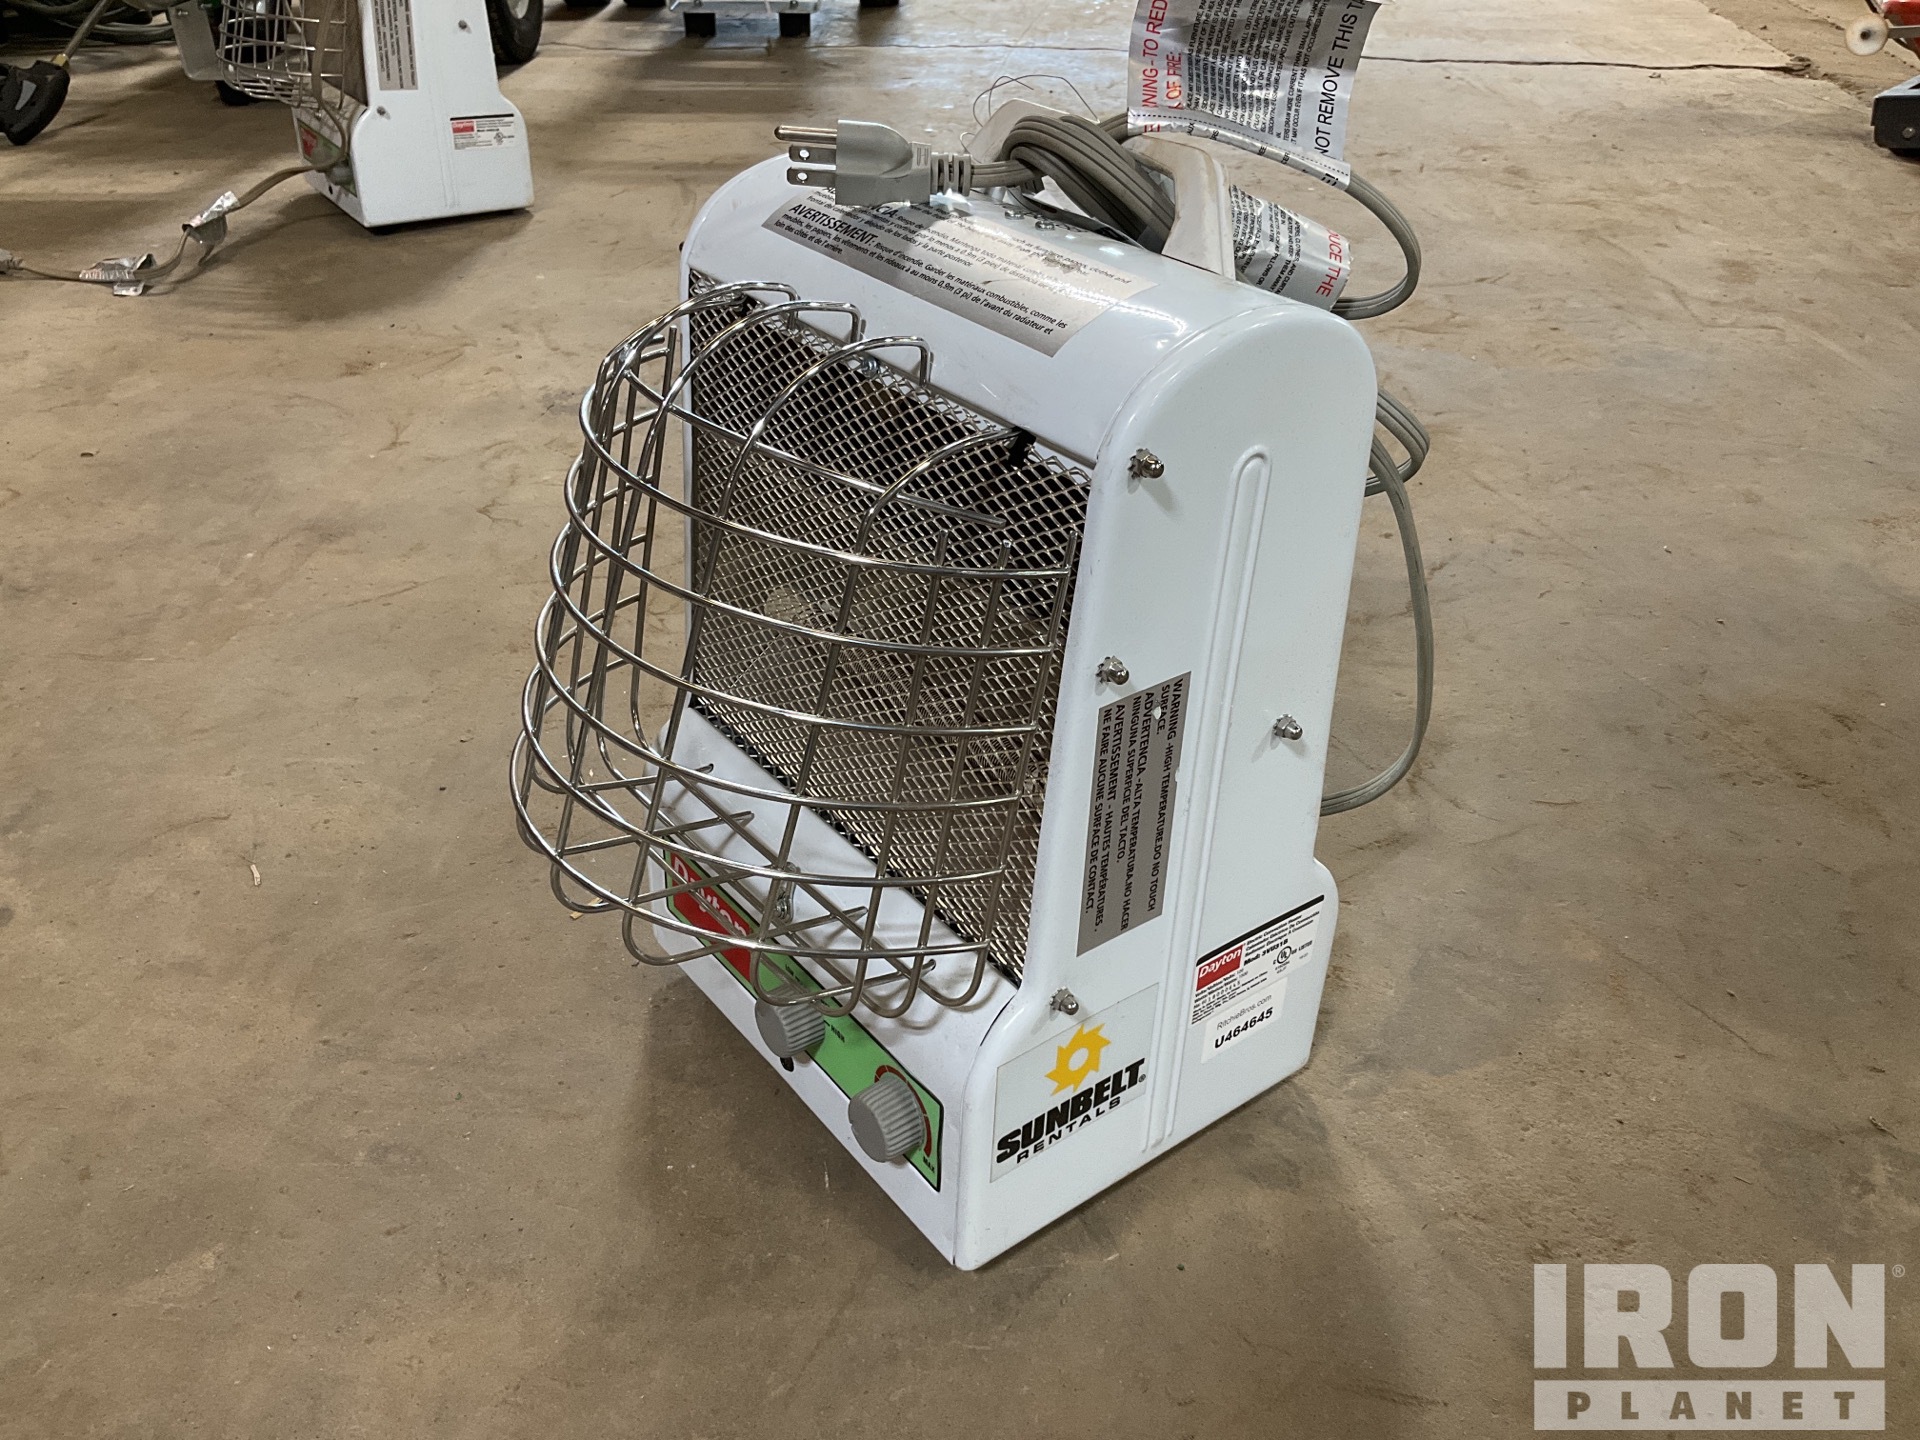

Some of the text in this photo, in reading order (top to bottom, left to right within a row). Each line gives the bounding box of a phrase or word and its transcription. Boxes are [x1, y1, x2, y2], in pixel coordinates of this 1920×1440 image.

[1230, 9, 1237, 17] BY
[1280, 8, 1290, 23] SURE
[1306, 18, 1321, 52] OCCURRED
[1317, 3, 1326, 16] WITH
[1200, 26, 1206, 35] OF
[1206, 24, 1216, 49] HEATER
[1214, 18, 1226, 46] BECAUSE
[1223, 18, 1234, 43] IGNITED
[1239, 32, 1248, 47] WALL
[1260, 50, 1269, 69] CAUSE
[1270, 18, 1278, 27] BE
[1275, 24, 1285, 42] MAKE
[1283, 29, 1292, 45] HAVE
[1221, 45, 1228, 53] BE
[1272, 43, 1279, 51] TO
[1278, 47, 1286, 59] AND
[1166, 52, 1182, 77] FIRE:
[1274, 60, 1283, 84] HEATER
[1288, 68, 1297, 95] CURRENT
[1293, 51, 1302, 66] THAN
[1298, 30, 1309, 49] SMALL
[1318, 56, 1344, 125] REMOVE
[1332, 14, 1358, 50] THIS
[1142, 68, 1158, 107] NING
[1166, 81, 1181, 99] OF
[773, 219, 785, 227] loin
[793, 229, 808, 238] côtés
[926, 246, 945, 255] parte
[1262, 253, 1278, 276] PILLOWS
[782, 213, 804, 226] meubles,
[810, 227, 831, 239] papiers,
[841, 239, 869, 254] vêtements
[883, 258, 905, 270] rideaux
[918, 273, 938, 284] moins
[937, 280, 954, 291] 0,9m
[979, 298, 1004, 312] l'avant
[1012, 314, 1044, 330] radiateur
[789, 204, 877, 245] AVERTISSEMENT:
[873, 242, 893, 253] Risque
[892, 250, 923, 266] d'incendie.
[924, 264, 946, 275] Garder
[944, 272, 955, 280] les
[954, 277, 985, 293] matériaux
[985, 290, 1028, 313] combustibles,
[1029, 310, 1056, 324] comme
[1055, 319, 1067, 328] les
[1287, 263, 1296, 275] AND
[1257, 277, 1264, 285] OR
[1316, 267, 1341, 297] THE
[1156, 684, 1170, 734] SURFACE.
[1167, 678, 1182, 739] WARNING
[1136, 692, 1153, 775] ADVERTENCIA
[1116, 695, 1141, 862] NINGUNA SUPERFICIE DEL TACTO.
[1085, 708, 1112, 913] NE FAIRE AUCUNE SURFACE DE CONTACT.
[1095, 704, 1124, 925] AVERTISSEMENT HAUTES TEMPÉRATURES
[1151, 861, 1160, 876] NO
[1147, 877, 1158, 911] TOUCH
[1120, 898, 1130, 930] HACER
[1199, 948, 1241, 978] Dayton
[1217, 995, 1272, 1030] RitchieBros.com
[1214, 1007, 1273, 1048] U464645
[997, 1058, 1145, 1163] SUNBELT
[1017, 1096, 1120, 1163] RENTALS
